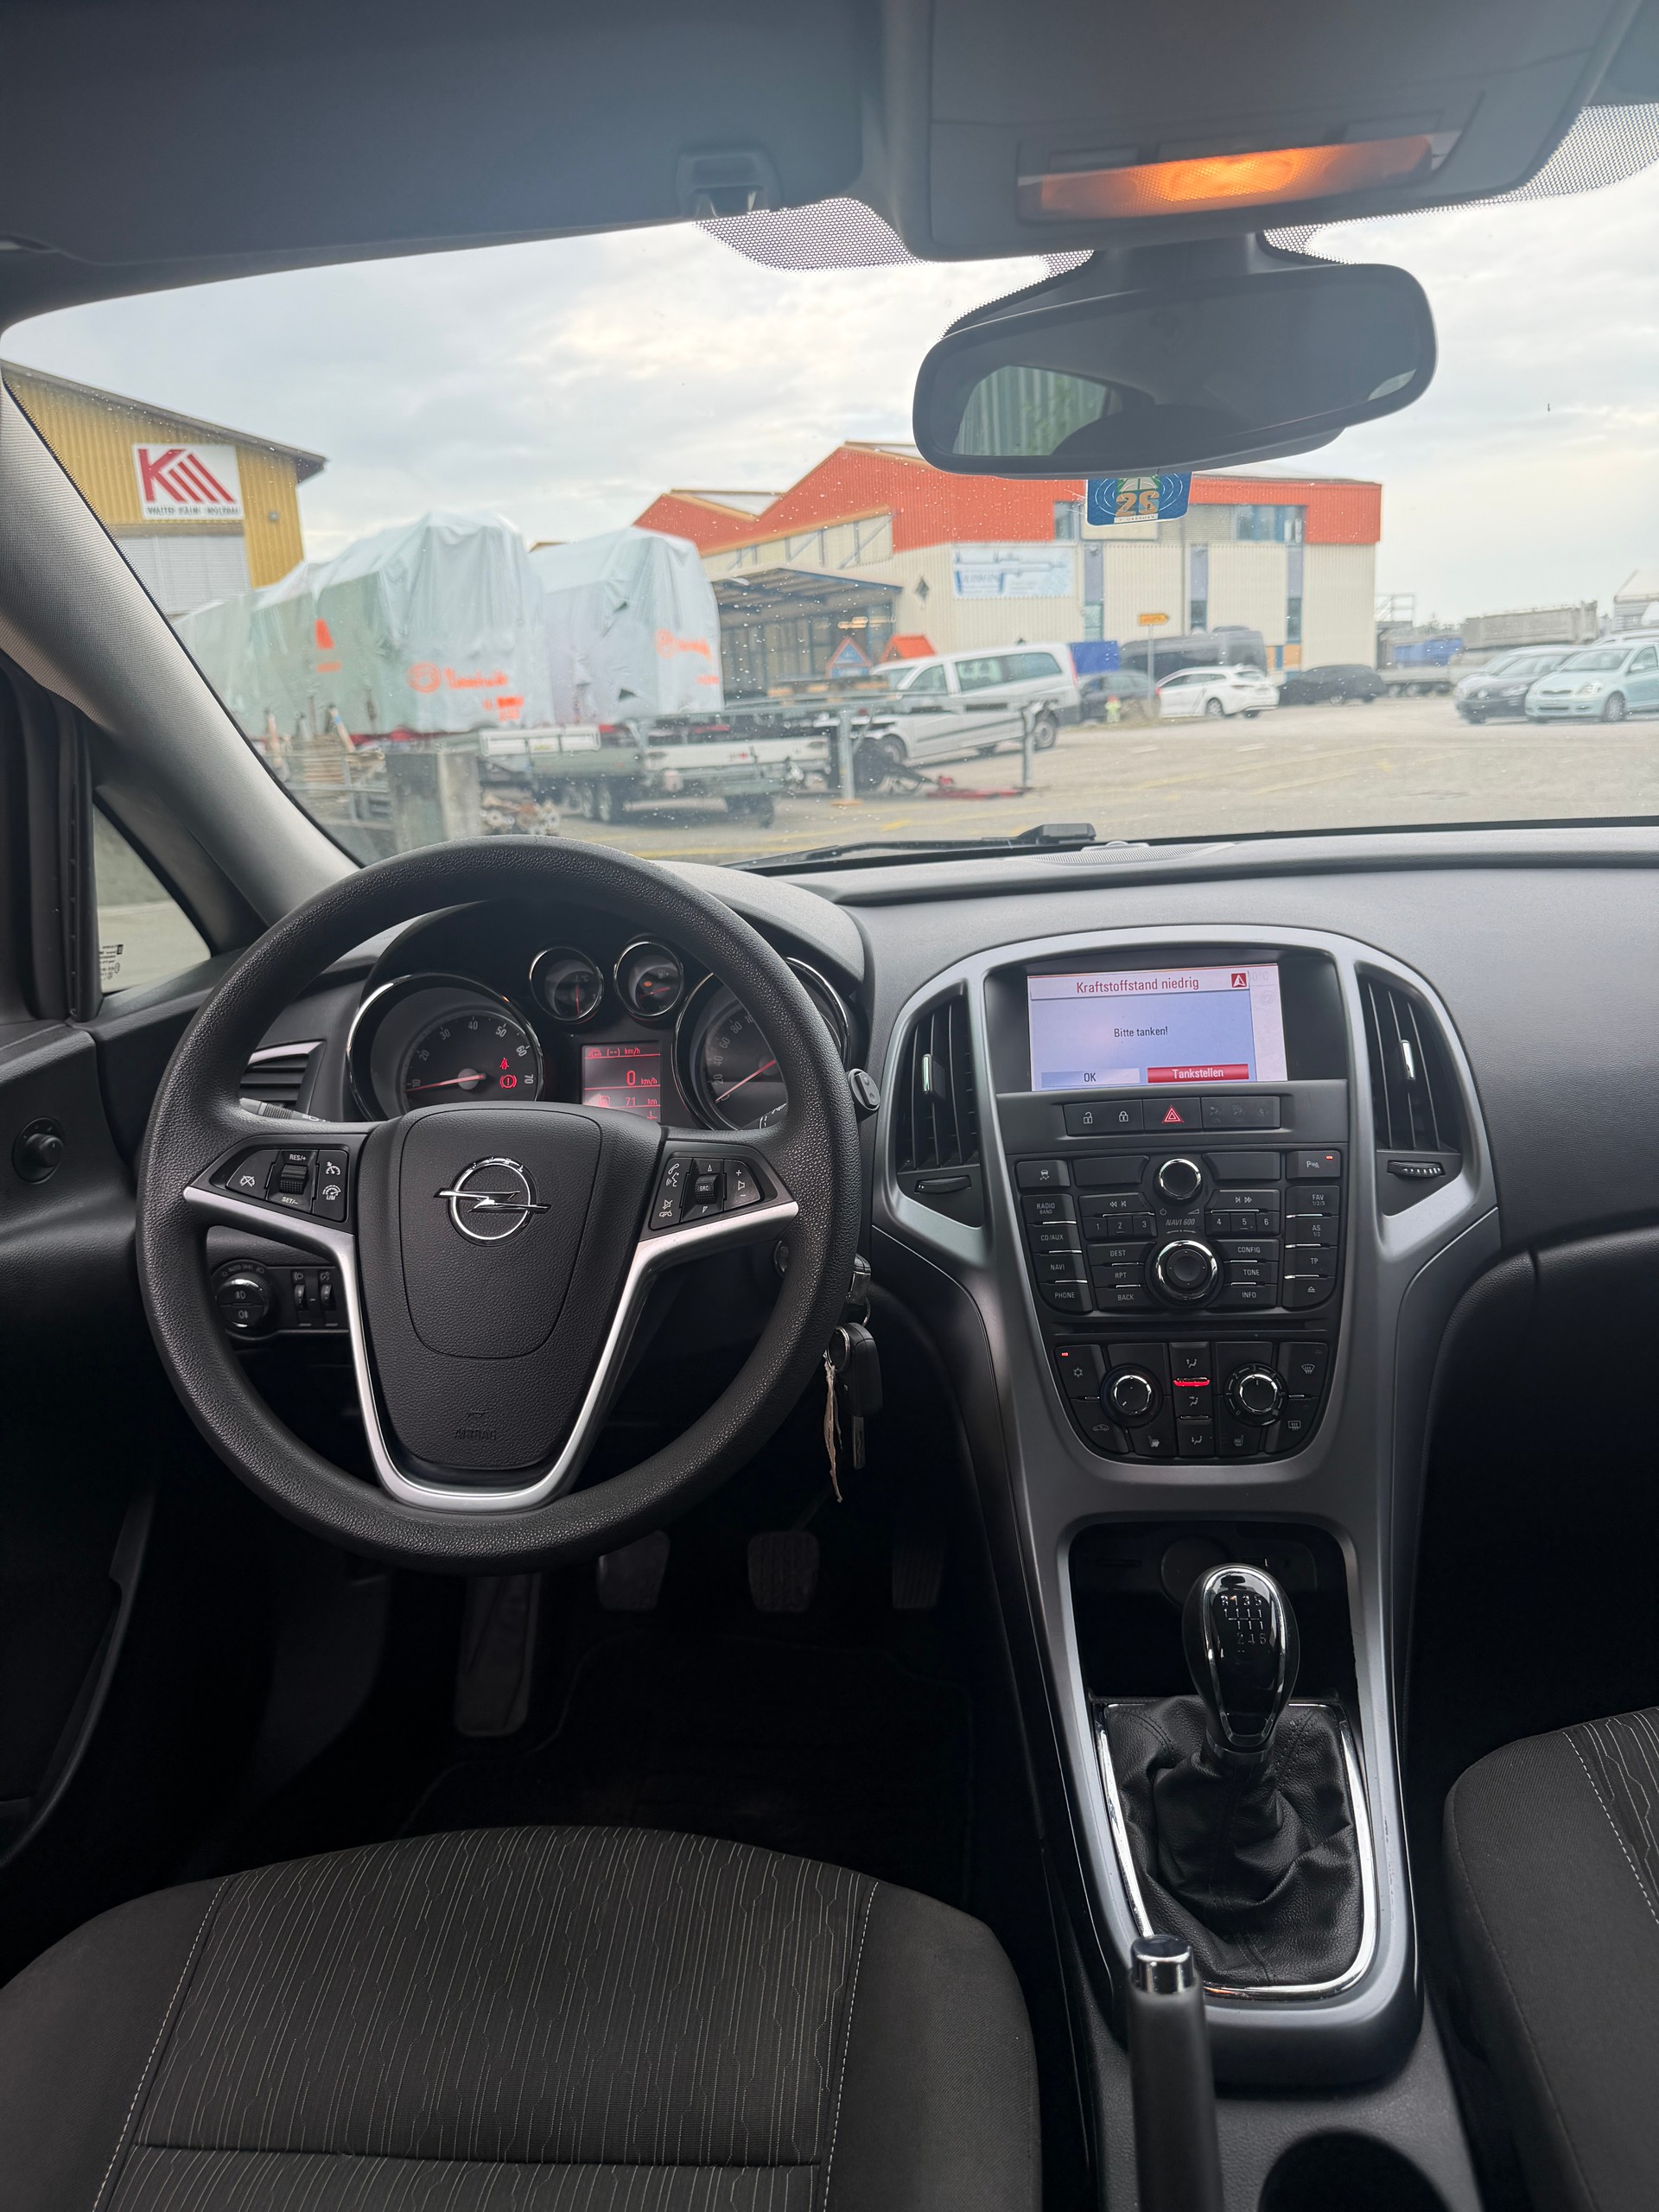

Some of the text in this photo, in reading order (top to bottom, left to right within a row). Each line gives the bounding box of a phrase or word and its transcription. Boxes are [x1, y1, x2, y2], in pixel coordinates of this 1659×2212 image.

[1077, 976, 1199, 994] Kraftstoffstand niedrig
[467, 1020, 479, 1030] 40
[730, 1021, 743, 1034] 80
[439, 1028, 451, 1040] 30
[495, 1026, 507, 1038] 50
[1114, 1026, 1168, 1038] Bitte tanken!
[719, 1037, 731, 1049] 60
[419, 1049, 430, 1062] 20
[516, 1045, 528, 1058] 60
[714, 1055, 723, 1066] 40
[524, 1073, 534, 1084] 70
[626, 1070, 636, 1086] 0
[713, 1073, 724, 1085] 20
[1084, 1072, 1096, 1082] OK
[1172, 1068, 1224, 1079] Tankstellen
[412, 1078, 421, 1088] 10
[626, 1096, 636, 1107] 71
[1040, 1233, 1065, 1242] CD/AUX
[1243, 1596, 1249, 1605] 3
